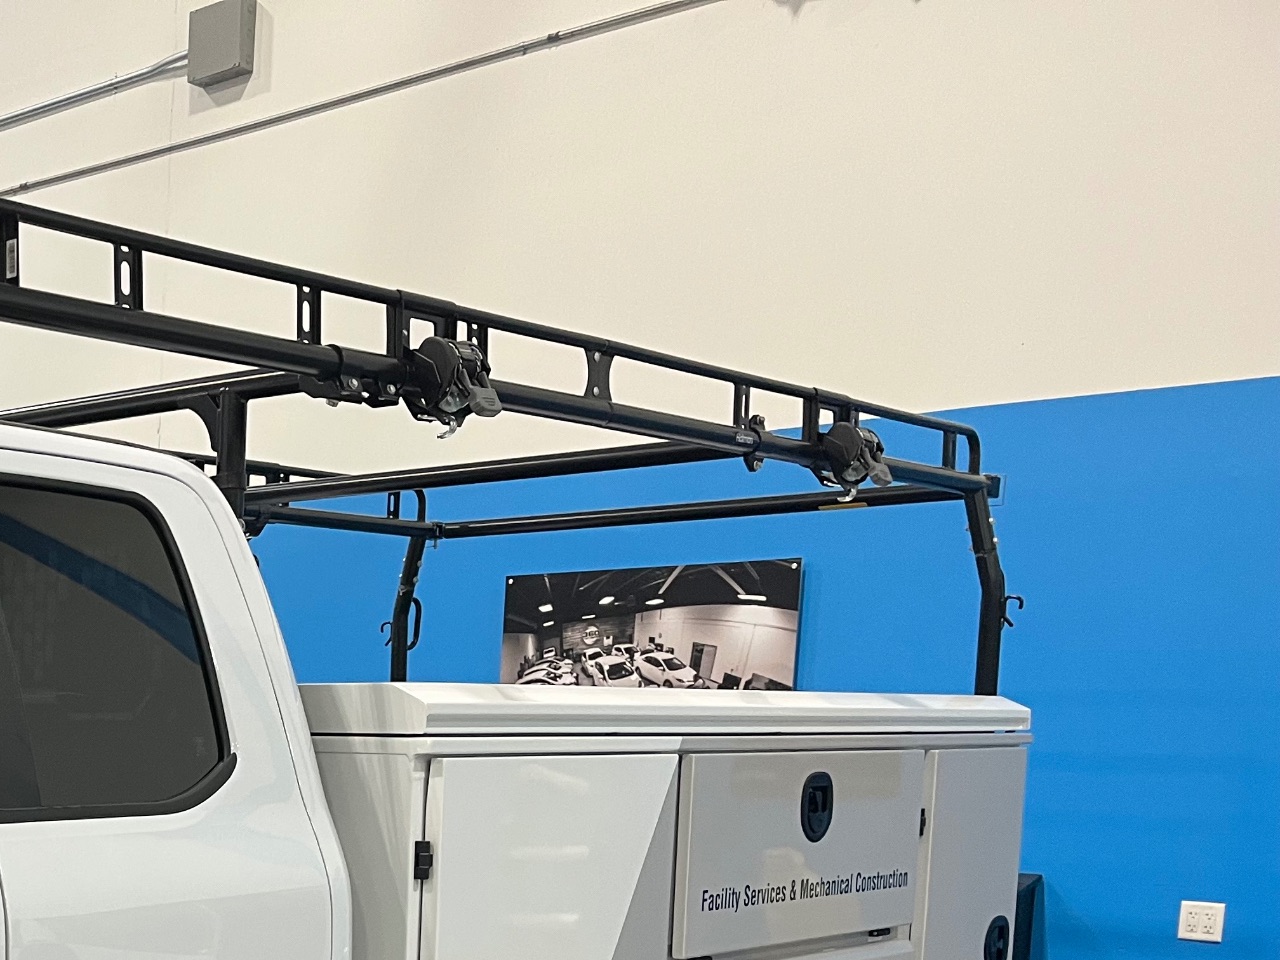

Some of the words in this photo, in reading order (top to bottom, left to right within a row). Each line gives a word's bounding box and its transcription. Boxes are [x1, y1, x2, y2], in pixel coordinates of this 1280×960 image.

[701, 888, 741, 912] Facility
[743, 882, 787, 907] Services
[789, 880, 797, 901] &
[800, 874, 853, 899] Mechanical
[855, 869, 908, 893] Construction
